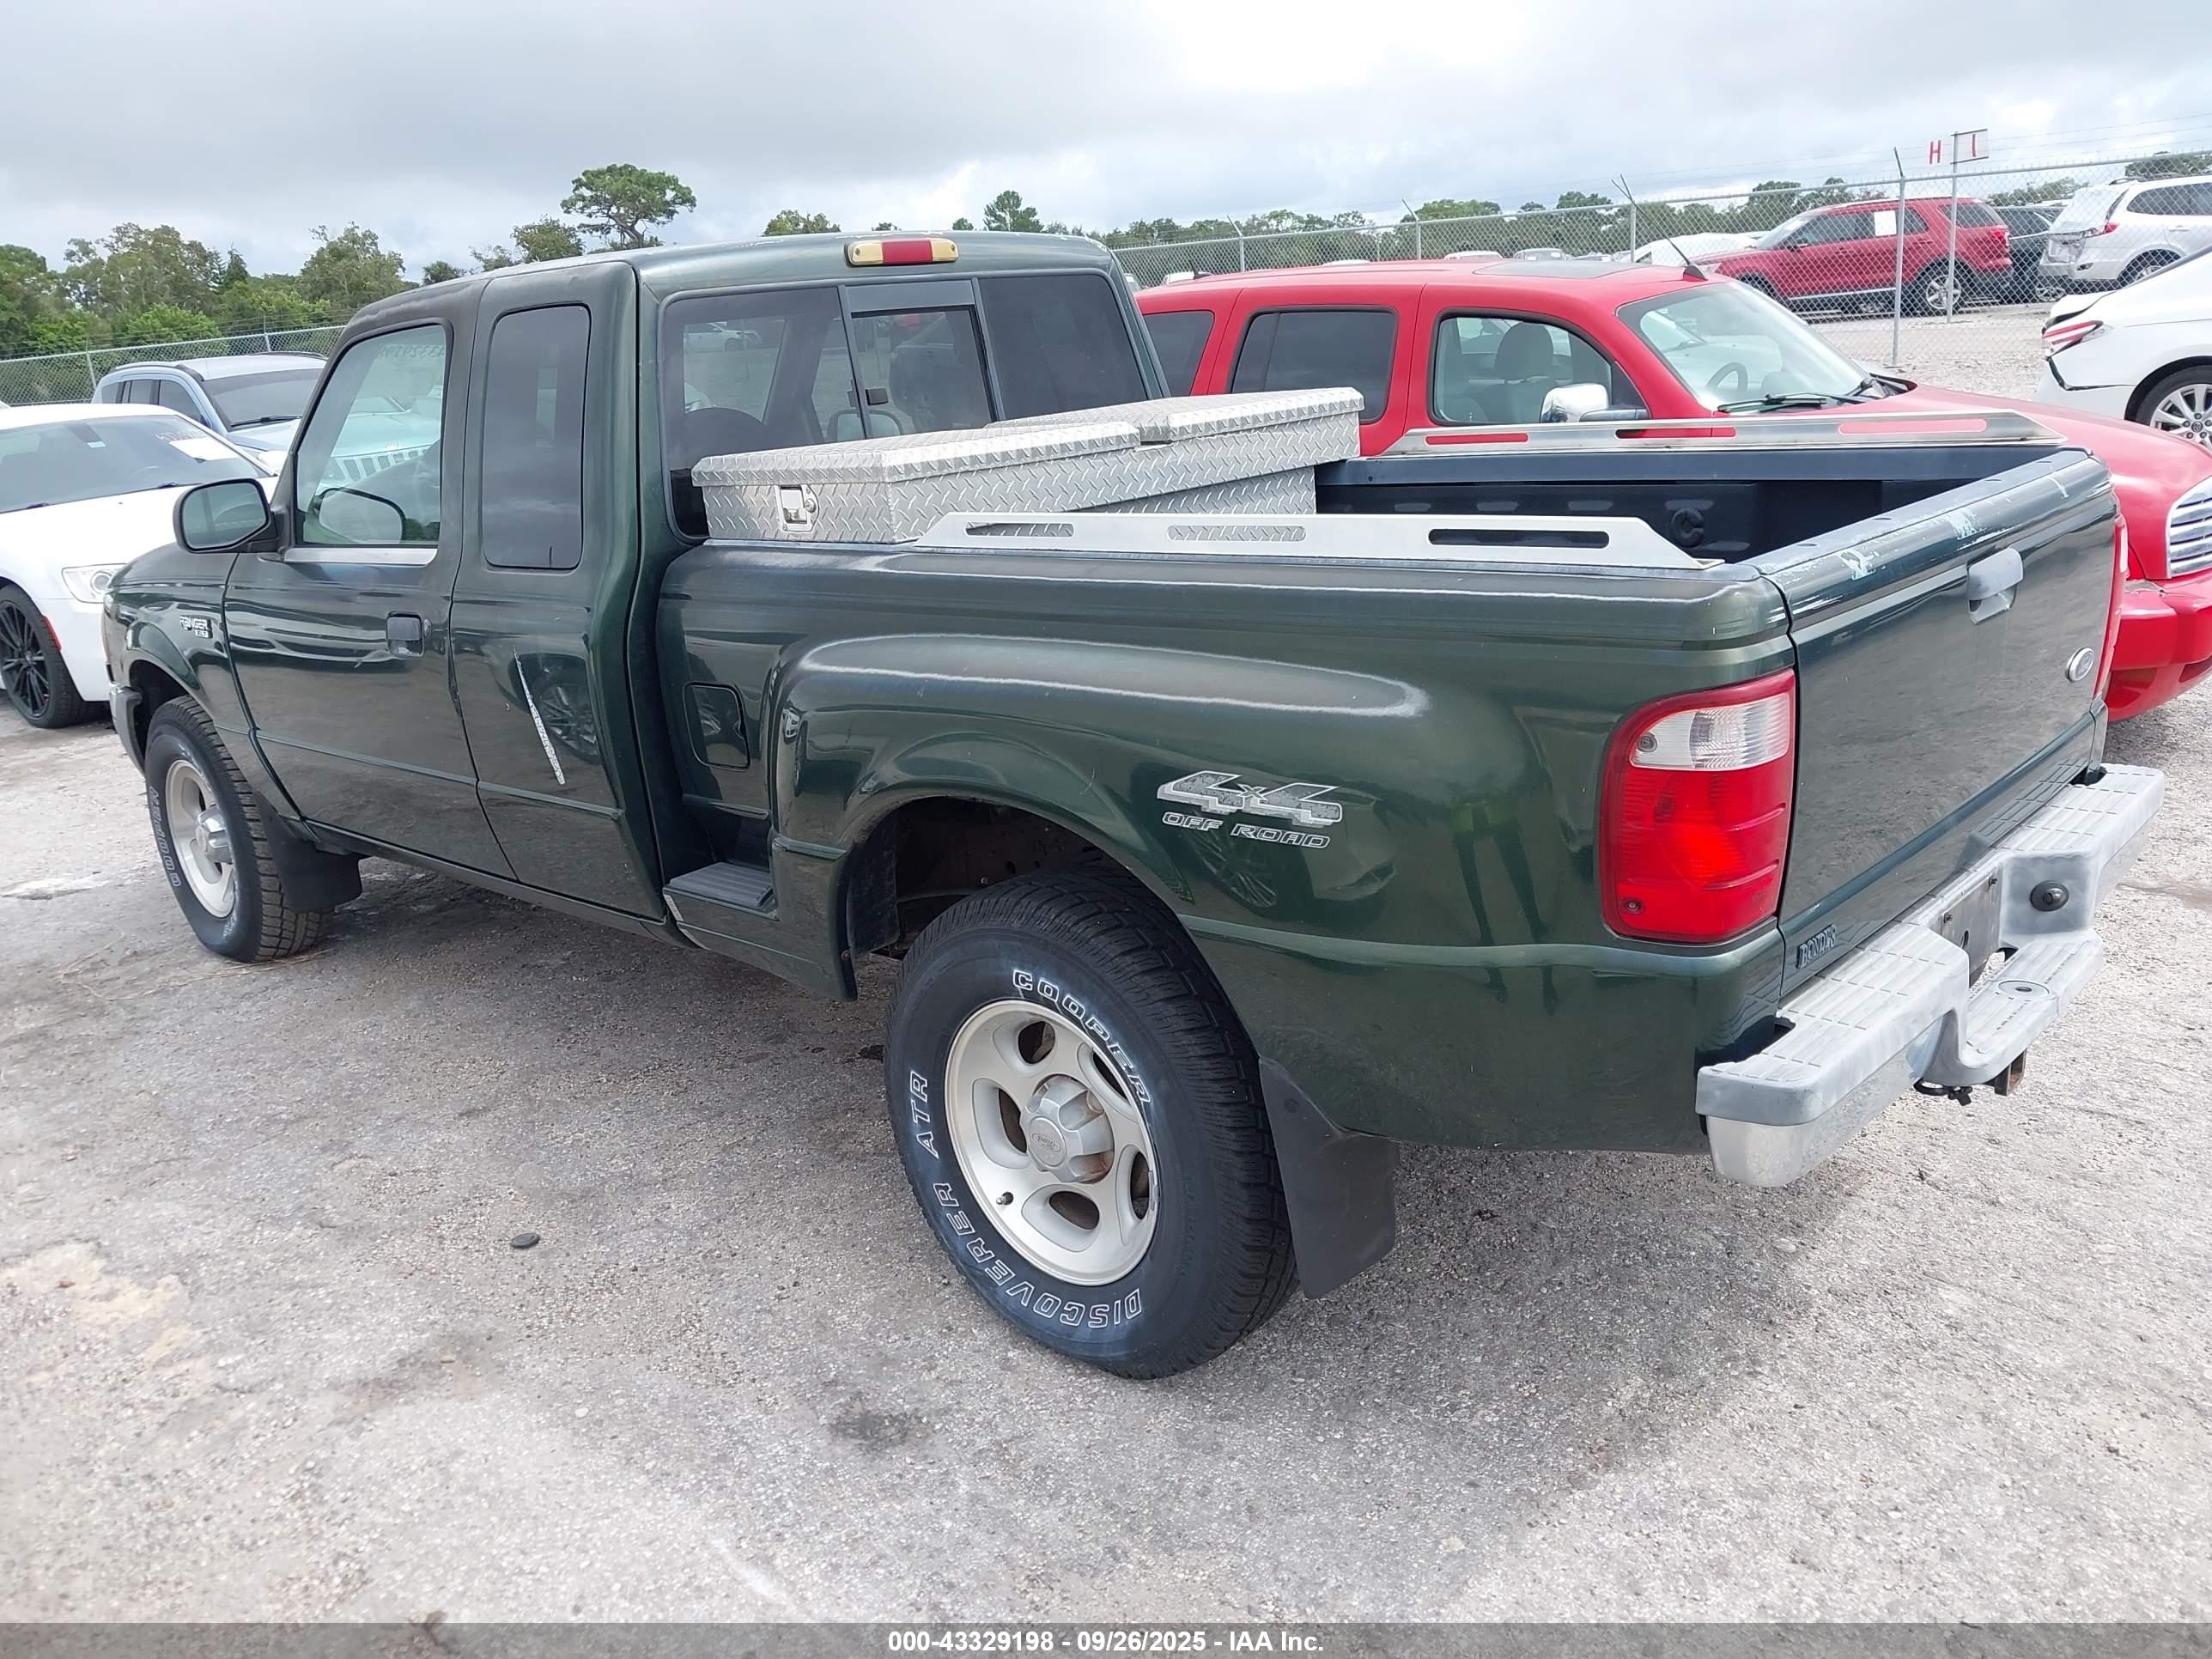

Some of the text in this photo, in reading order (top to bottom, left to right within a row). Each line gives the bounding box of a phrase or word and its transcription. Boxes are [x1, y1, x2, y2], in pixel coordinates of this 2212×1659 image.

[1929, 139, 1942, 165] H
[1162, 811, 1331, 848] OFF ROAD
[1013, 969, 1152, 1103] COOPER
[908, 1070, 1142, 1328] DISCOVERER ATR
